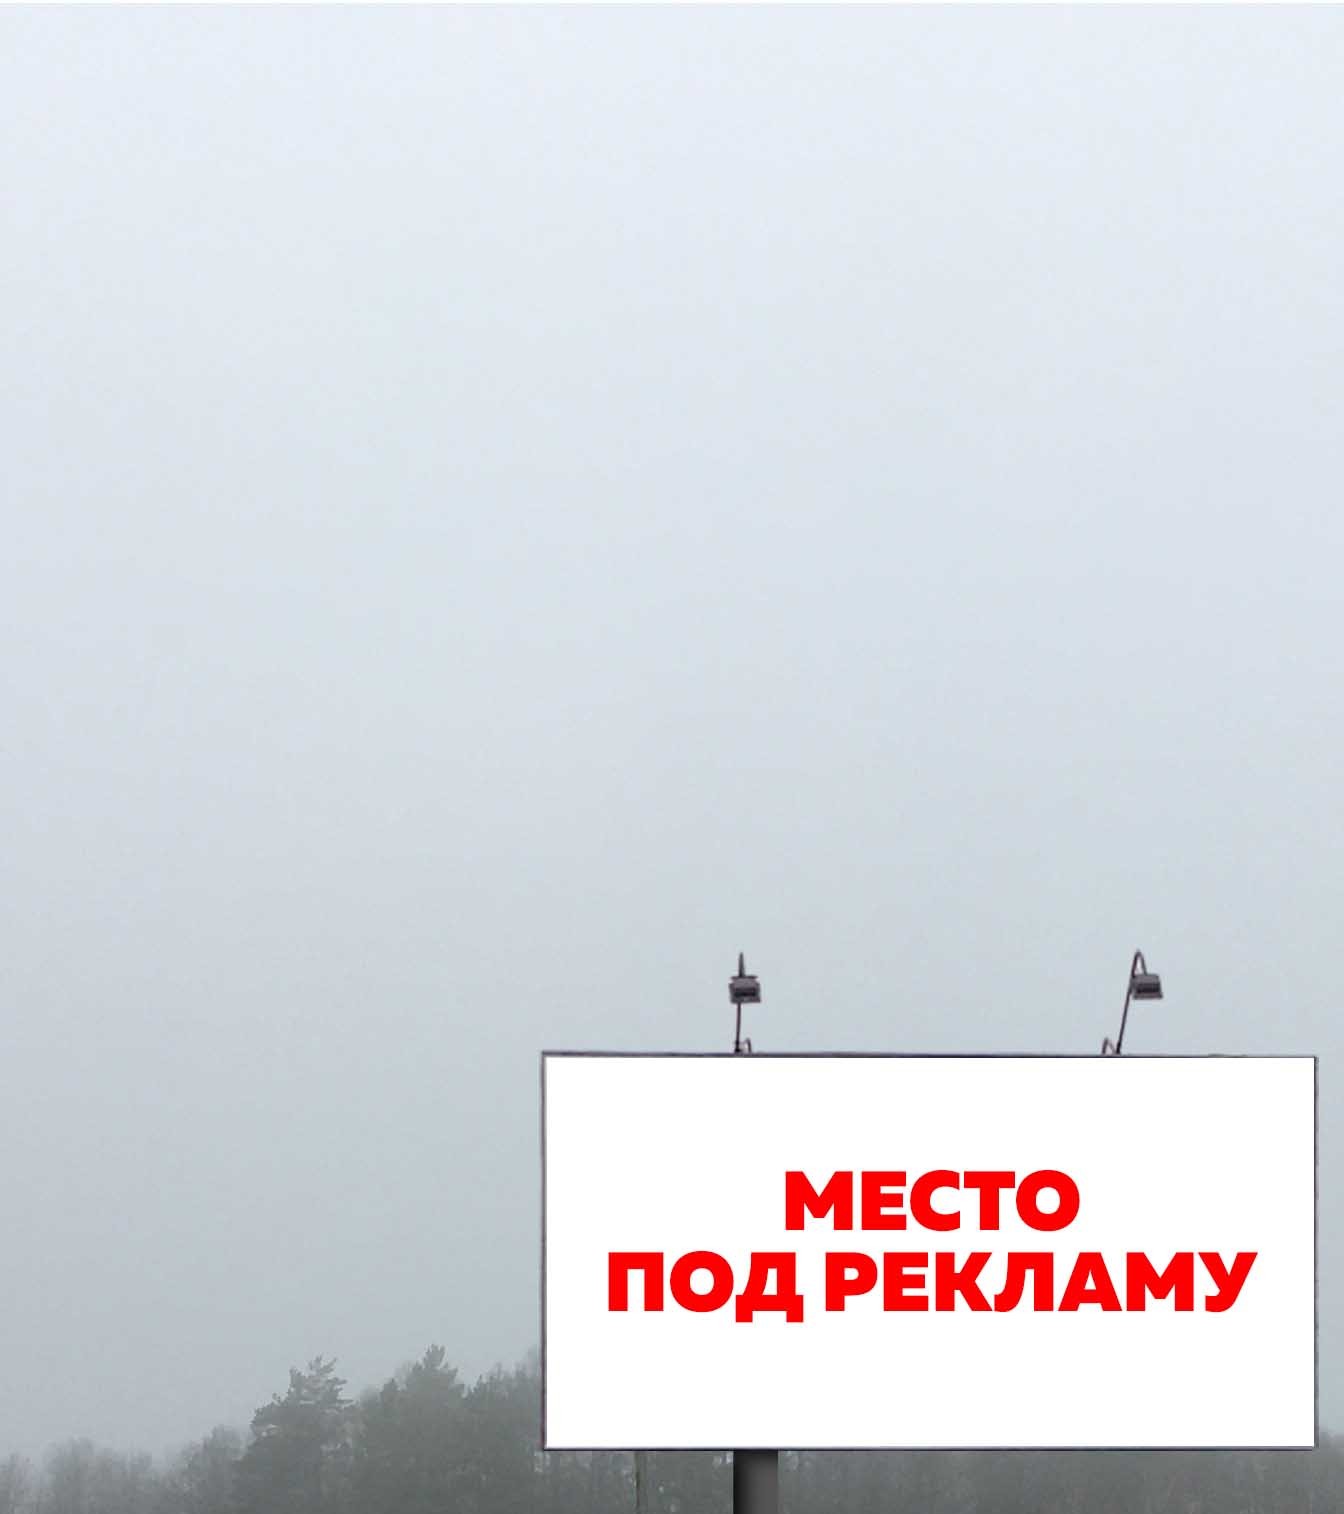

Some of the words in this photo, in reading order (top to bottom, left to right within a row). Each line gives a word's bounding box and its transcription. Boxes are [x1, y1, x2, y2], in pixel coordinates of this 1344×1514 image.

[785, 1169, 1080, 1232] МЕСТО
[607, 1250, 804, 1323] ПОД
[824, 1251, 1258, 1313] РЕКЛАМУ
